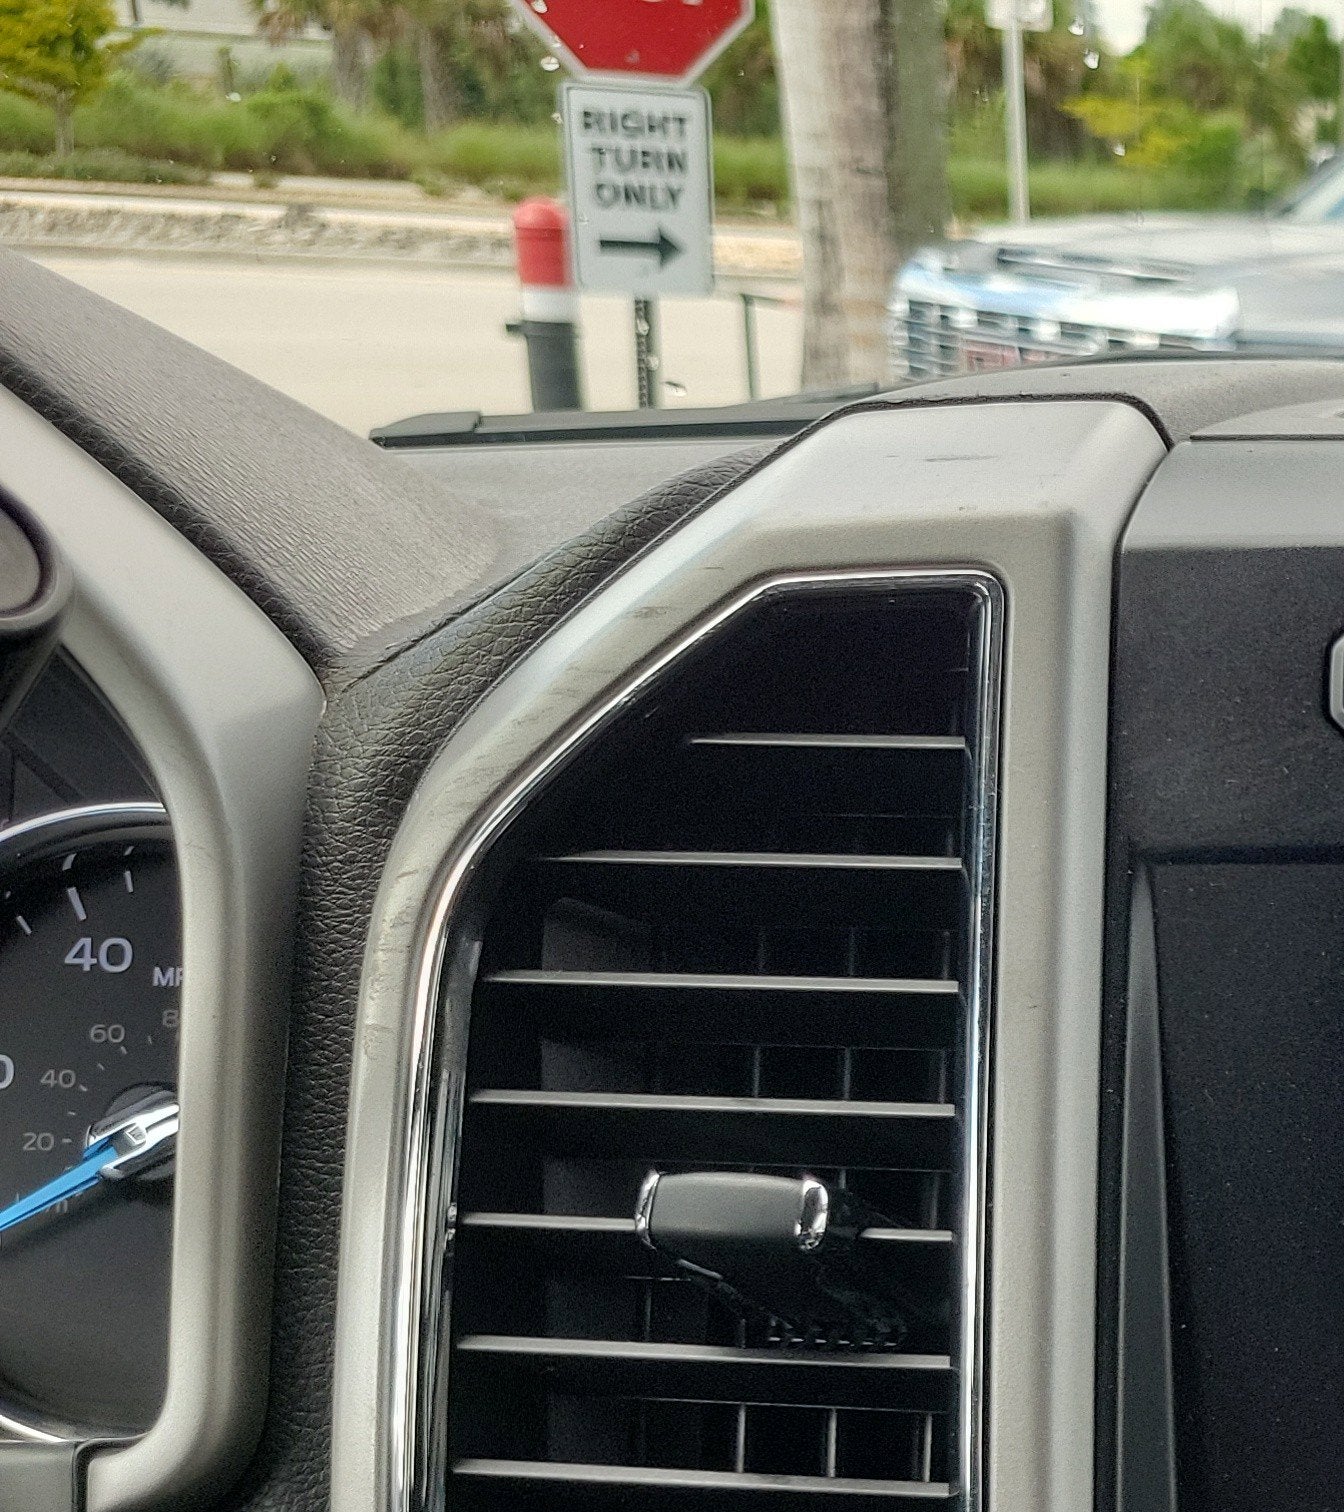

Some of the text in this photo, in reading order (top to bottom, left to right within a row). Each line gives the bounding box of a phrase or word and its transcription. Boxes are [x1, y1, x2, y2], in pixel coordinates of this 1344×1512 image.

[583, 110, 687, 136] RIGHT
[590, 147, 687, 172] TURN
[595, 184, 682, 208] ONLY
[64, 937, 134, 974] 40
[89, 1024, 125, 1044] 60
[40, 1069, 76, 1089] 40
[22, 1132, 55, 1151] 20
